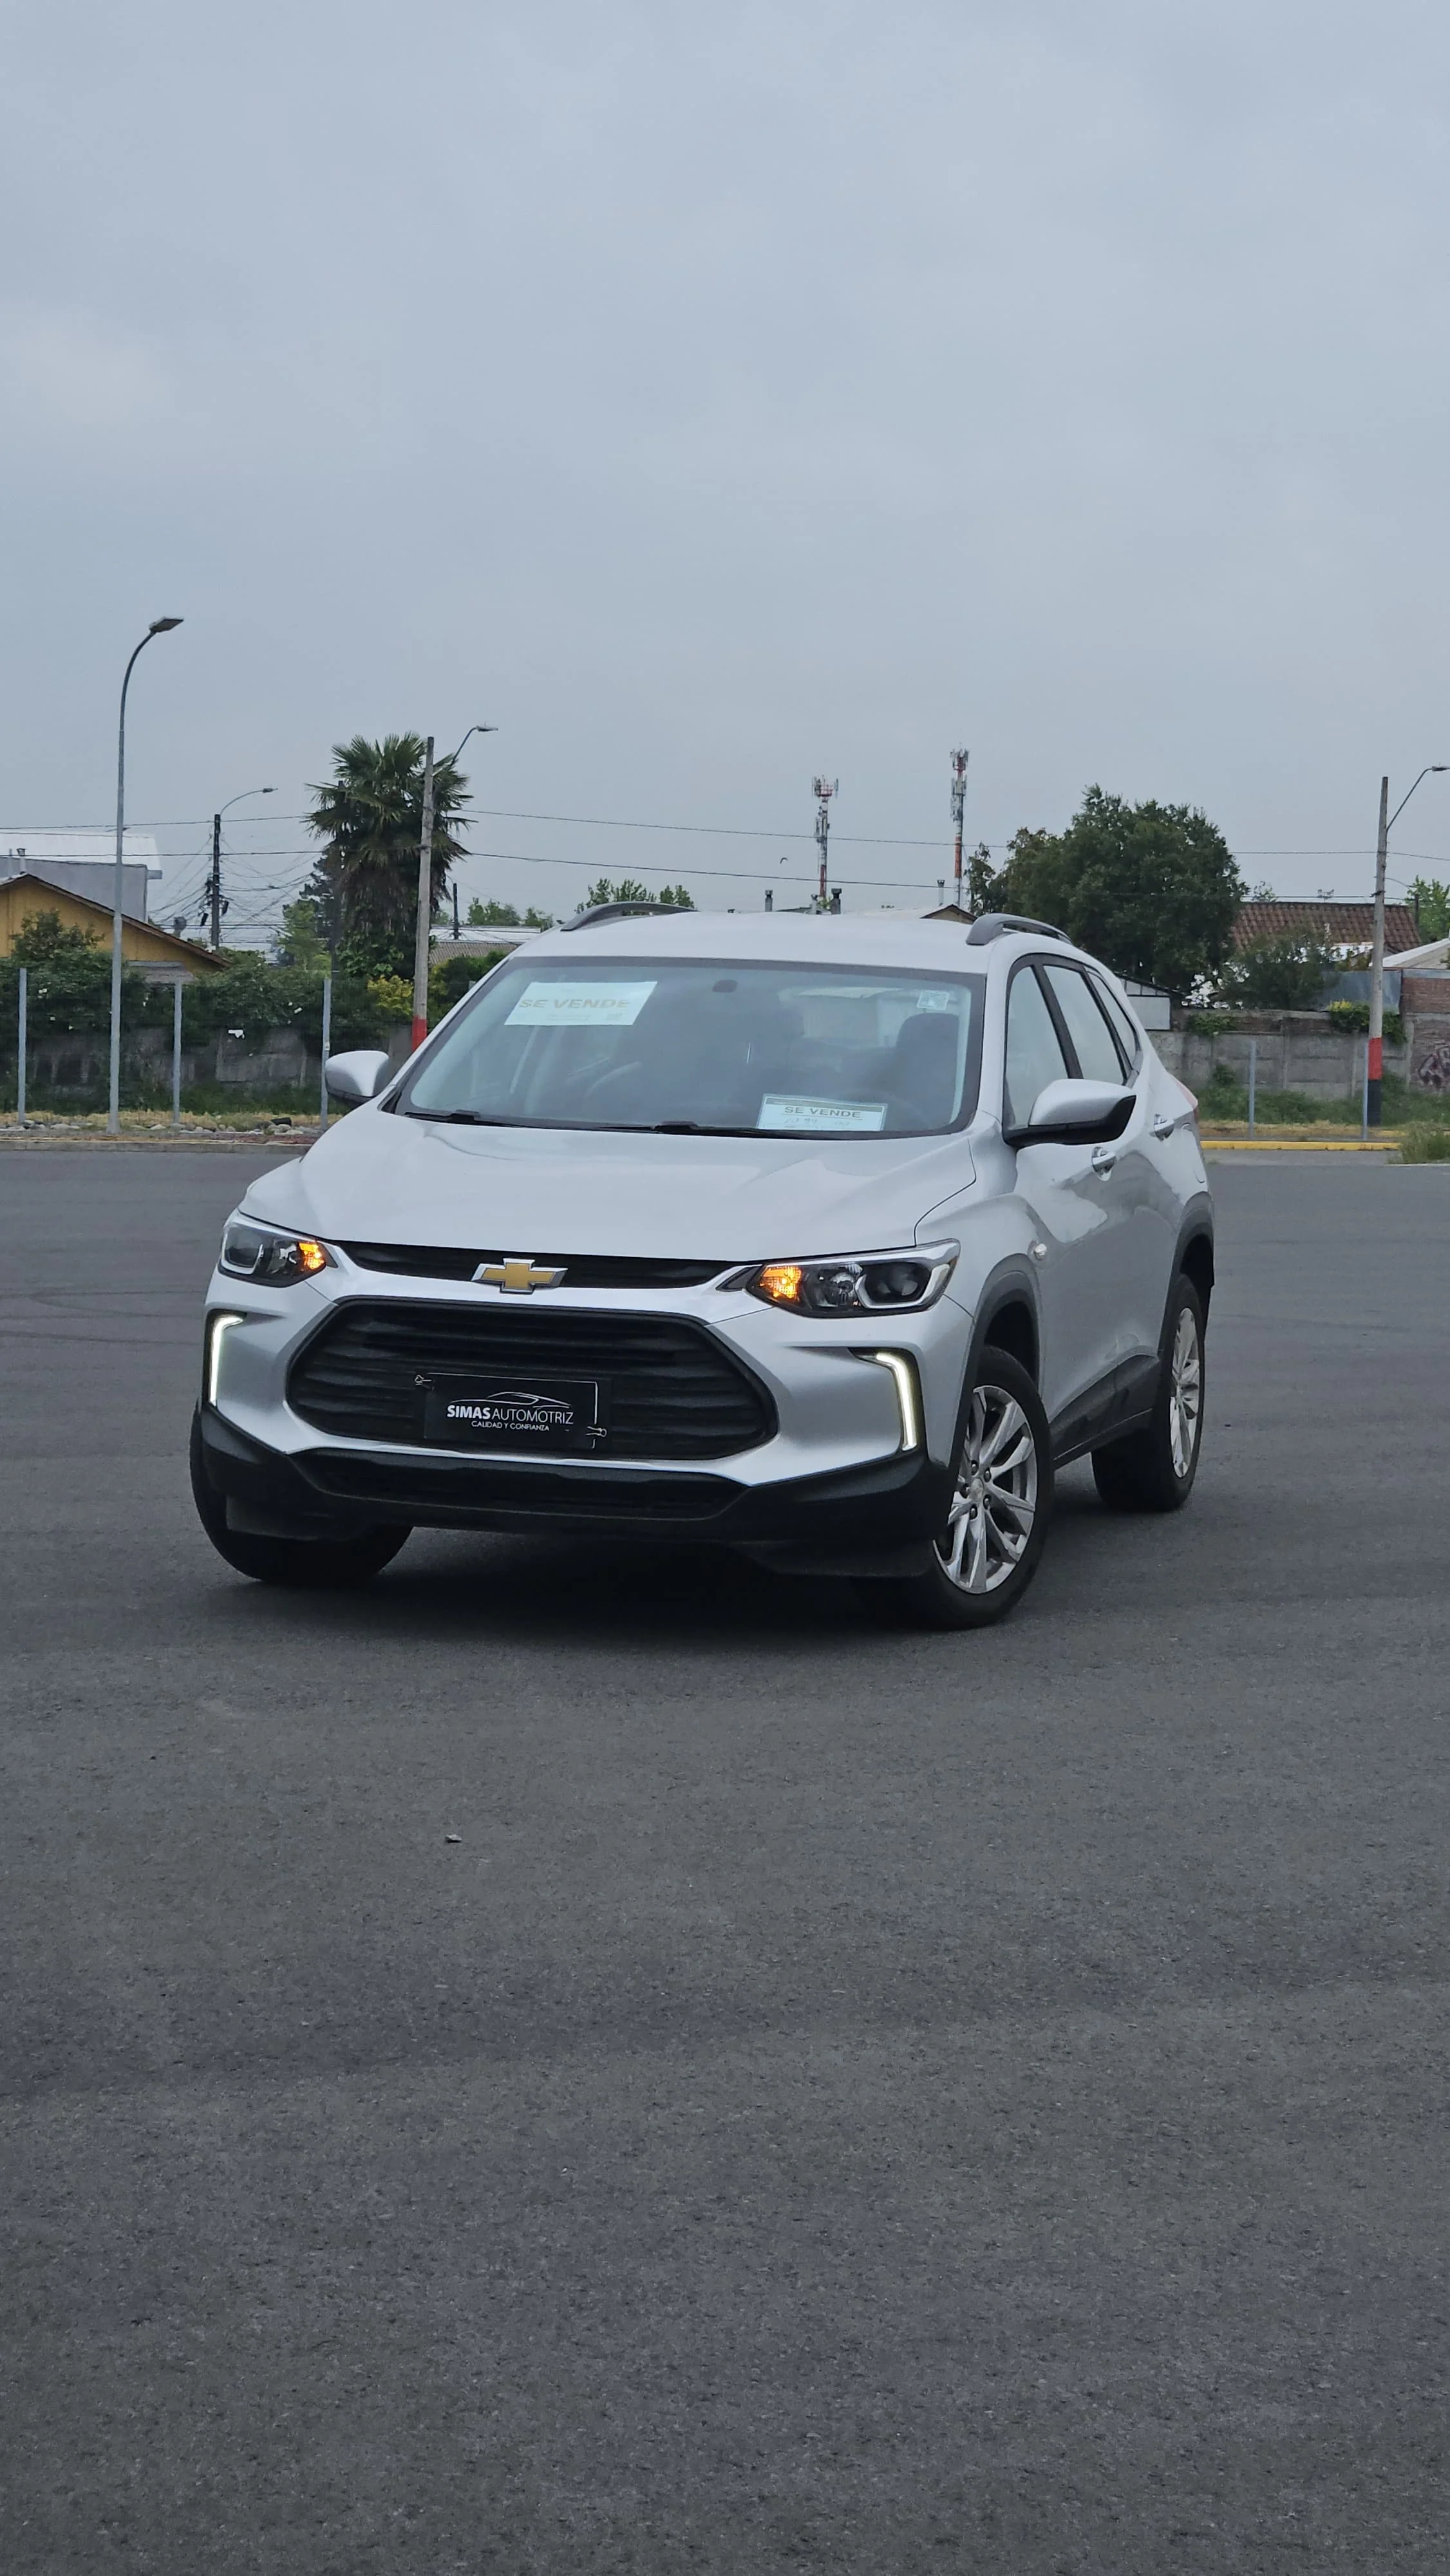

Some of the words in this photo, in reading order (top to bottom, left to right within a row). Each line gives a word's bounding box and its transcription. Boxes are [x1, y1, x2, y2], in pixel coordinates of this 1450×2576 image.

[519, 999, 549, 1008] SE
[554, 999, 630, 1009] VENDE
[810, 1108, 862, 1118] VENDE
[447, 1405, 491, 1419] SIMAS
[491, 1408, 574, 1425] AUTOMOTRIZ
[510, 1423, 550, 1431] CONFIANZA
